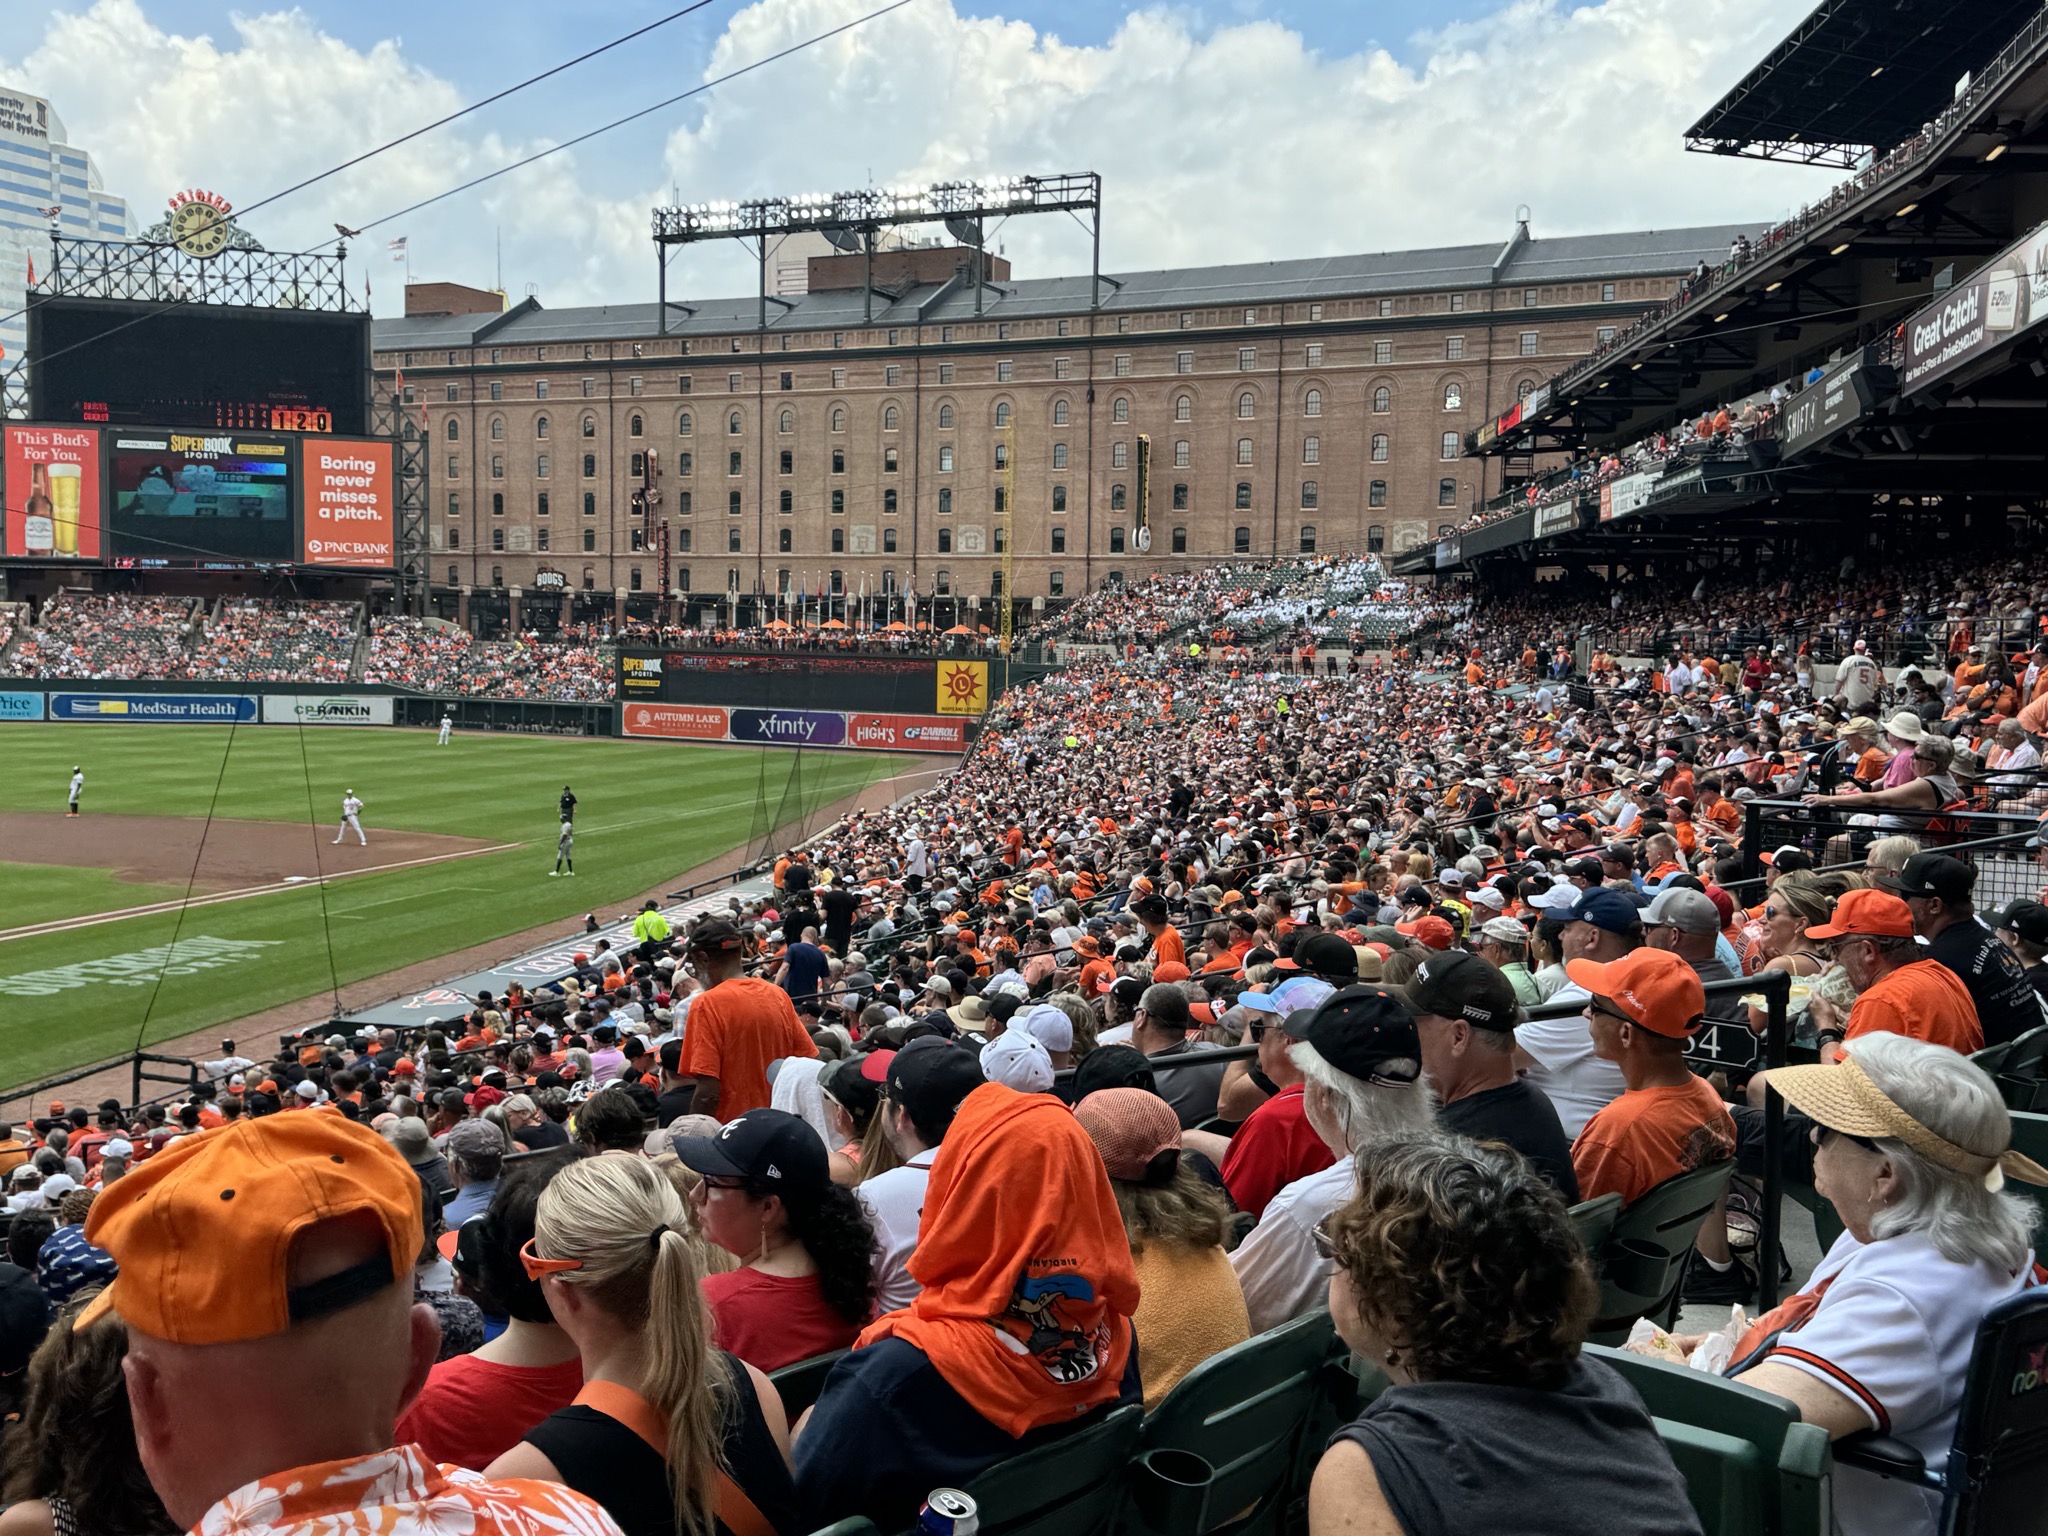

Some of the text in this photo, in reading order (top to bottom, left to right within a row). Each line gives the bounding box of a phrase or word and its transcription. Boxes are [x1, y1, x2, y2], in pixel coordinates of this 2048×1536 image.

[16, 122, 47, 139] System
[1914, 285, 1979, 356] Great Catch!
[297, 413, 306, 429] 2
[317, 414, 327, 430] 0
[14, 432, 90, 447] This Bud's
[170, 435, 233, 455] SUPERBOOK
[24, 447, 81, 461] For You.
[184, 451, 219, 460] SPORTS
[321, 455, 376, 475] Boring
[324, 475, 373, 488] never
[320, 488, 377, 504] misses
[319, 505, 382, 522] a pitch.
[324, 541, 389, 554] PNC BANK
[623, 657, 662, 673] SUPERBOOK
[1860, 668, 1870, 685] 5
[131, 702, 236, 715] MedStar Health
[654, 712, 721, 724] AUTUMN LAKE
[758, 714, 817, 740] xfinity
[857, 727, 895, 743] HIGH'S
[920, 726, 959, 737] CARROLL
[1973, 945, 1990, 975] Blind
